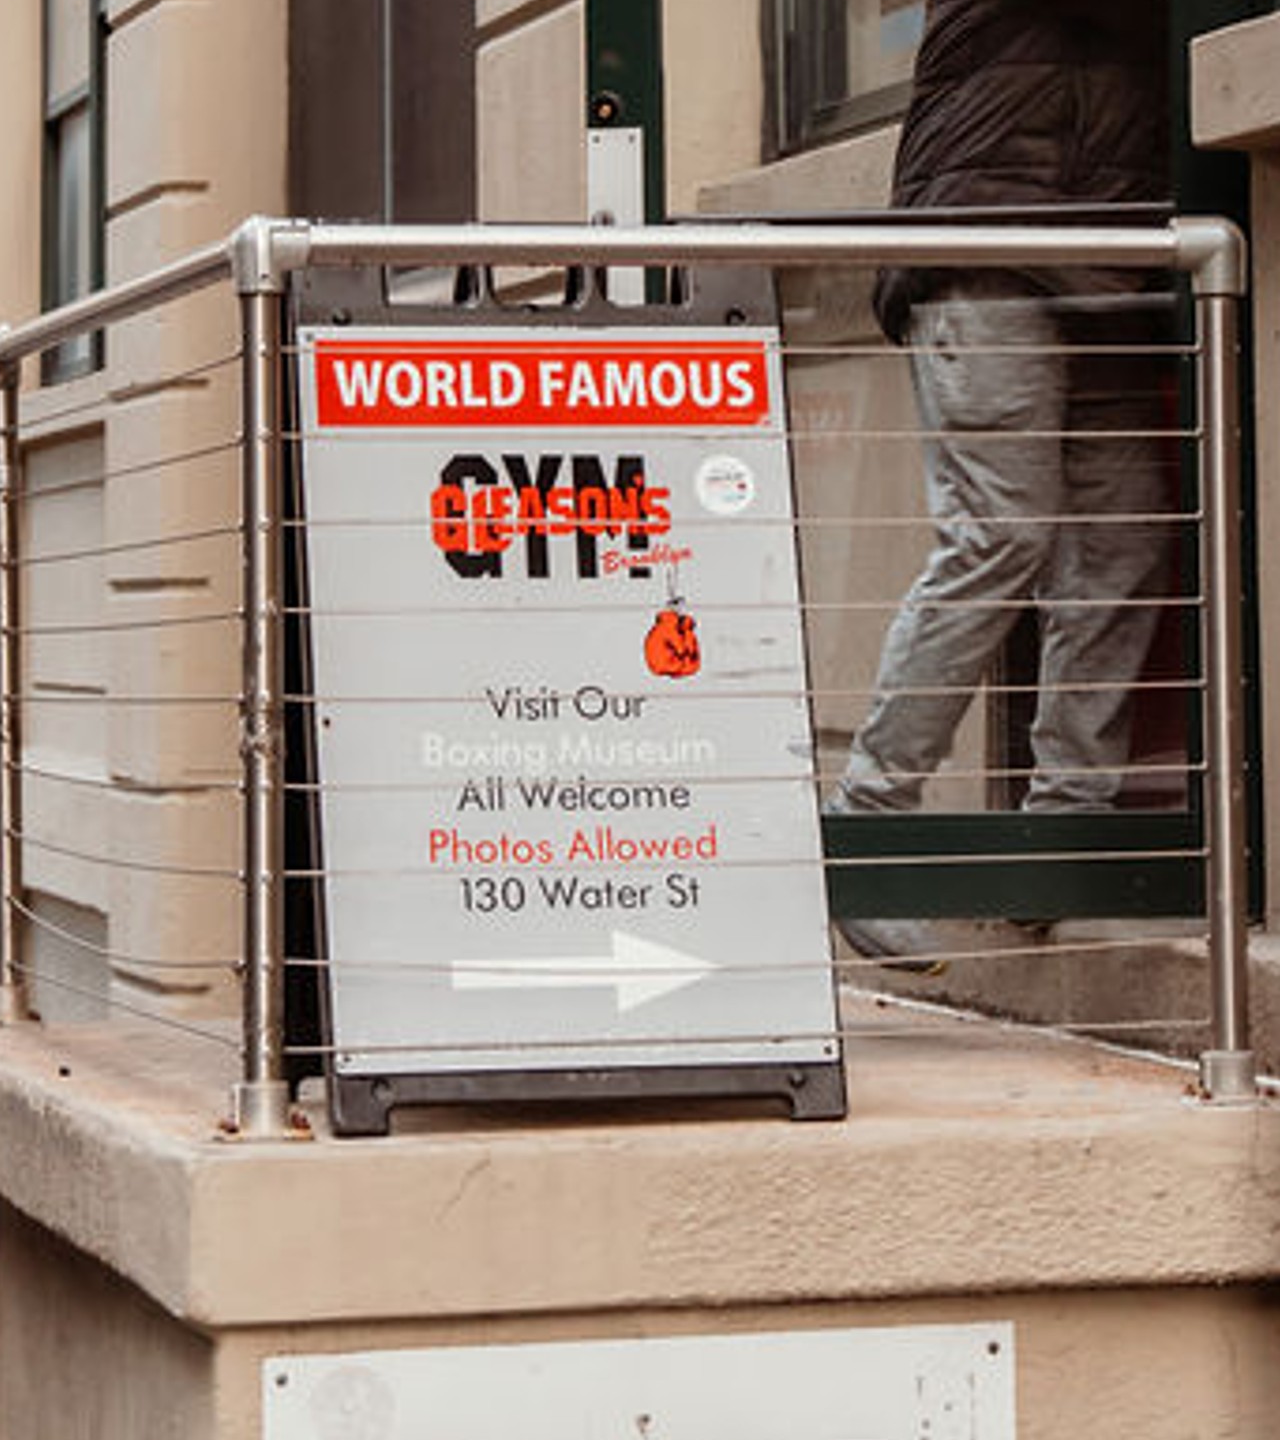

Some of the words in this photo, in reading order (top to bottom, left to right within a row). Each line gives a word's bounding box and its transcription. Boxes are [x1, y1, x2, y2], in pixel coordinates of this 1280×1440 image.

[333, 359, 524, 408] WORLD
[539, 359, 755, 408] FAMOUS
[430, 473, 671, 554] GLEASON'S
[439, 453, 651, 579] GYM
[486, 686, 560, 721] Visit
[573, 685, 647, 720] Our
[422, 733, 546, 773] Boxing
[557, 734, 716, 766] Museum
[457, 778, 504, 812] All
[522, 775, 690, 811] Welcome
[428, 828, 553, 865] Photos
[568, 825, 718, 863] Allowed
[459, 878, 526, 913] 130
[538, 876, 653, 910] Water
[666, 873, 700, 908] St
